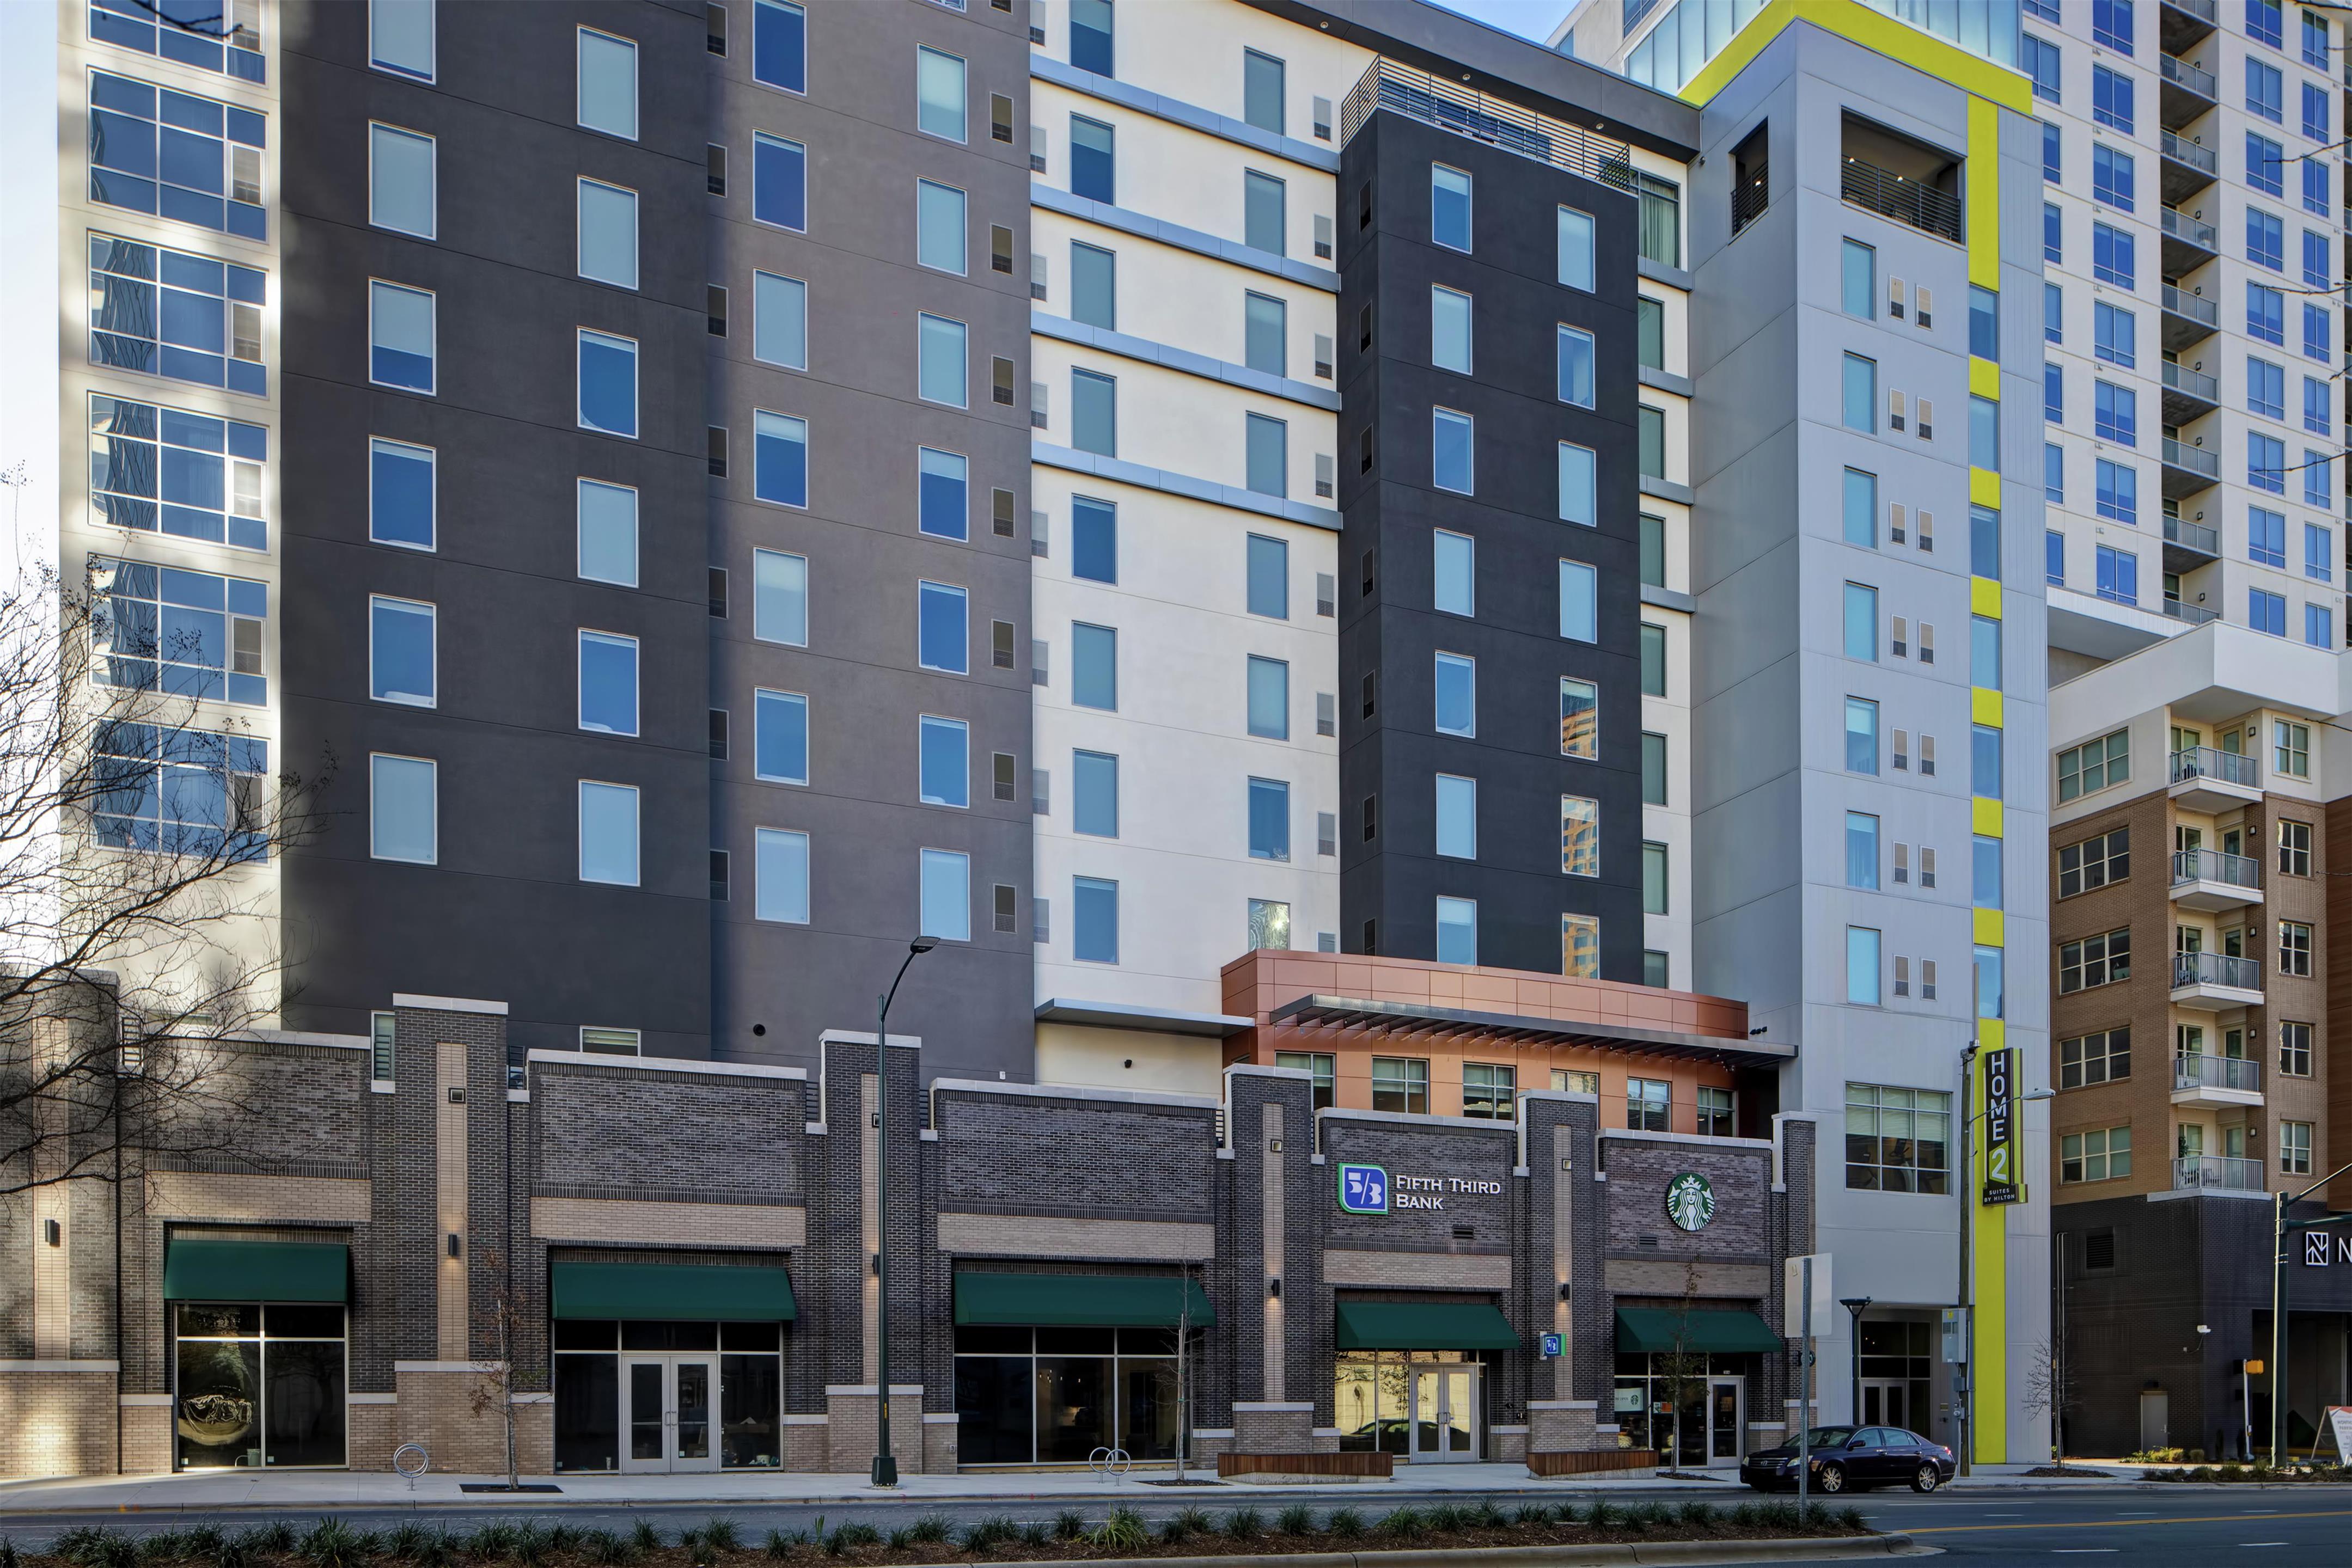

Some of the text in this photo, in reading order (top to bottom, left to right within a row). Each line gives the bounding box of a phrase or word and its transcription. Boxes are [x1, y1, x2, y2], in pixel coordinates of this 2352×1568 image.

[1990, 1052, 2007, 1141] HOME
[1991, 1147, 2007, 1181] 2
[1395, 1174, 1501, 1195] FIFTH THIRD
[1395, 1193, 1444, 1210] BANK
[1994, 1193, 2015, 1202] HILTON
